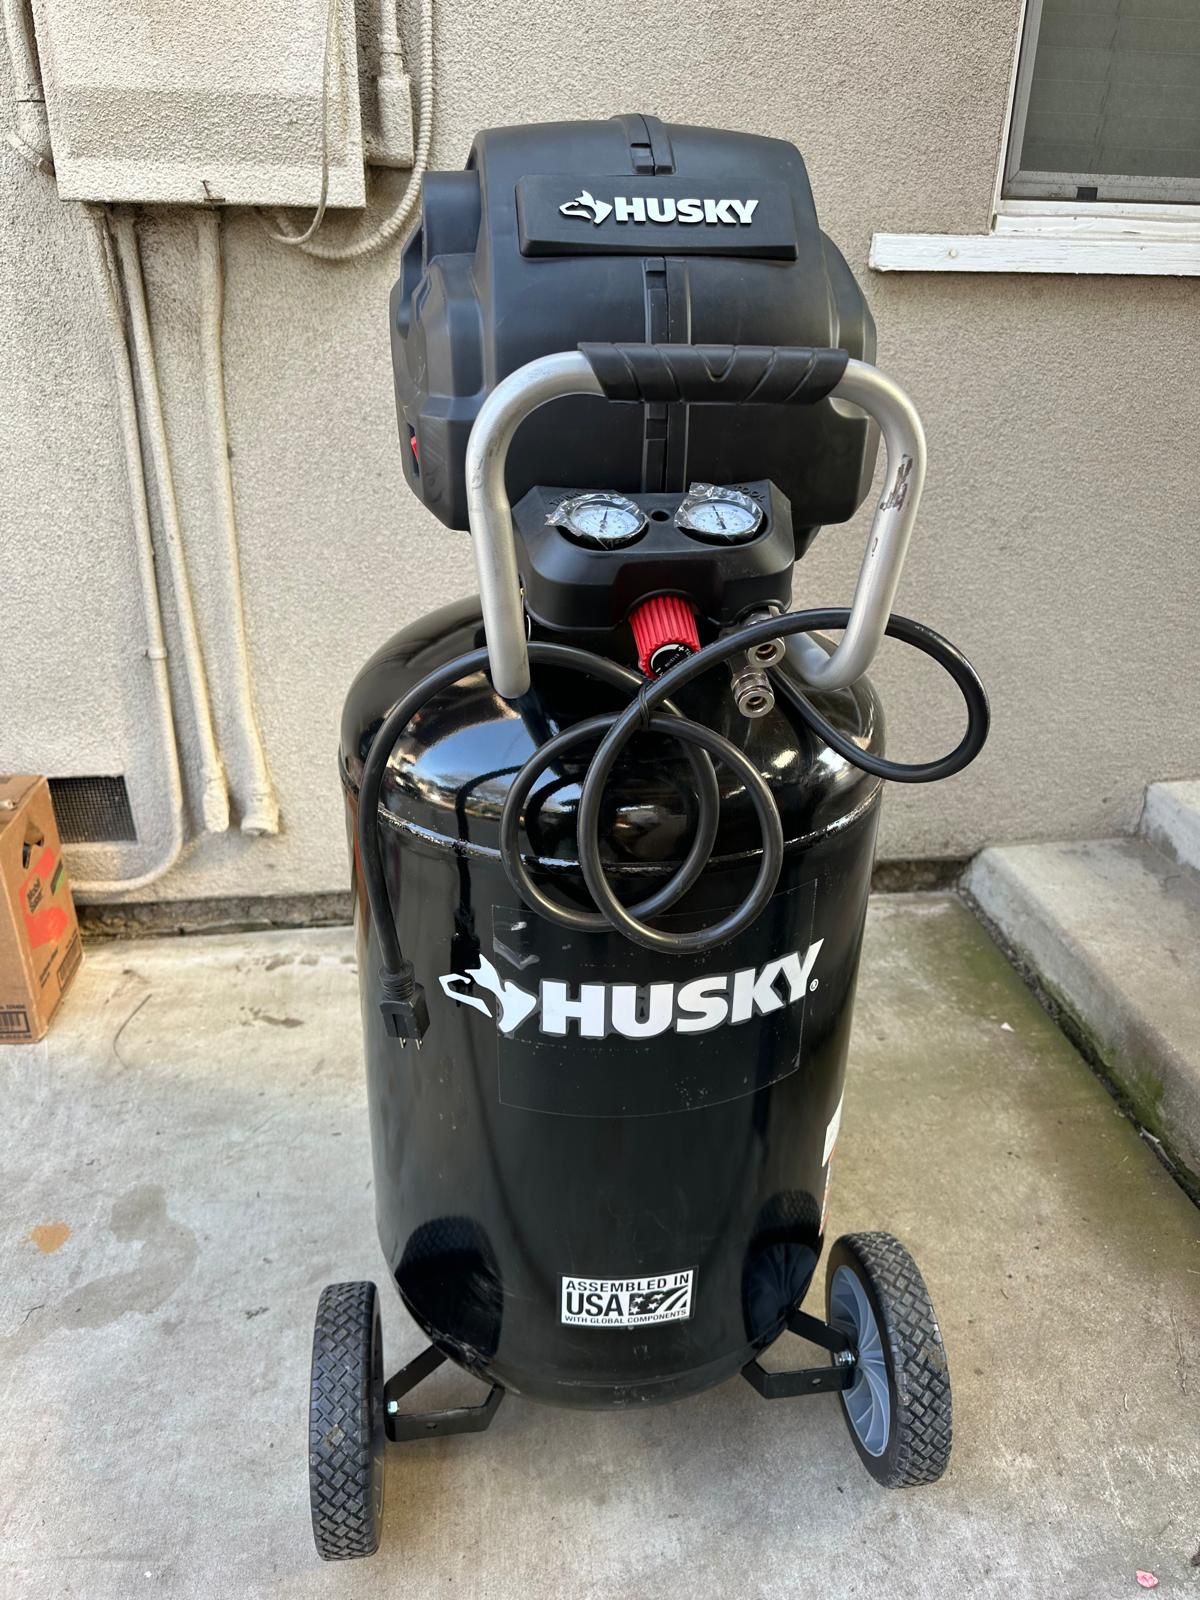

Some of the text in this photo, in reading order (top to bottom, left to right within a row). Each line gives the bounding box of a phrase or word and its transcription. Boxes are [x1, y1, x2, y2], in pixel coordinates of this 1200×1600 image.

[614, 197, 759, 224] HUSKY
[541, 938, 825, 1038] HUSKY
[566, 1273, 689, 1292] ASSEMBLED IN
[565, 1309, 687, 1325] WITH GLOBAL COMPONENTS
[566, 1292, 624, 1317] USA
